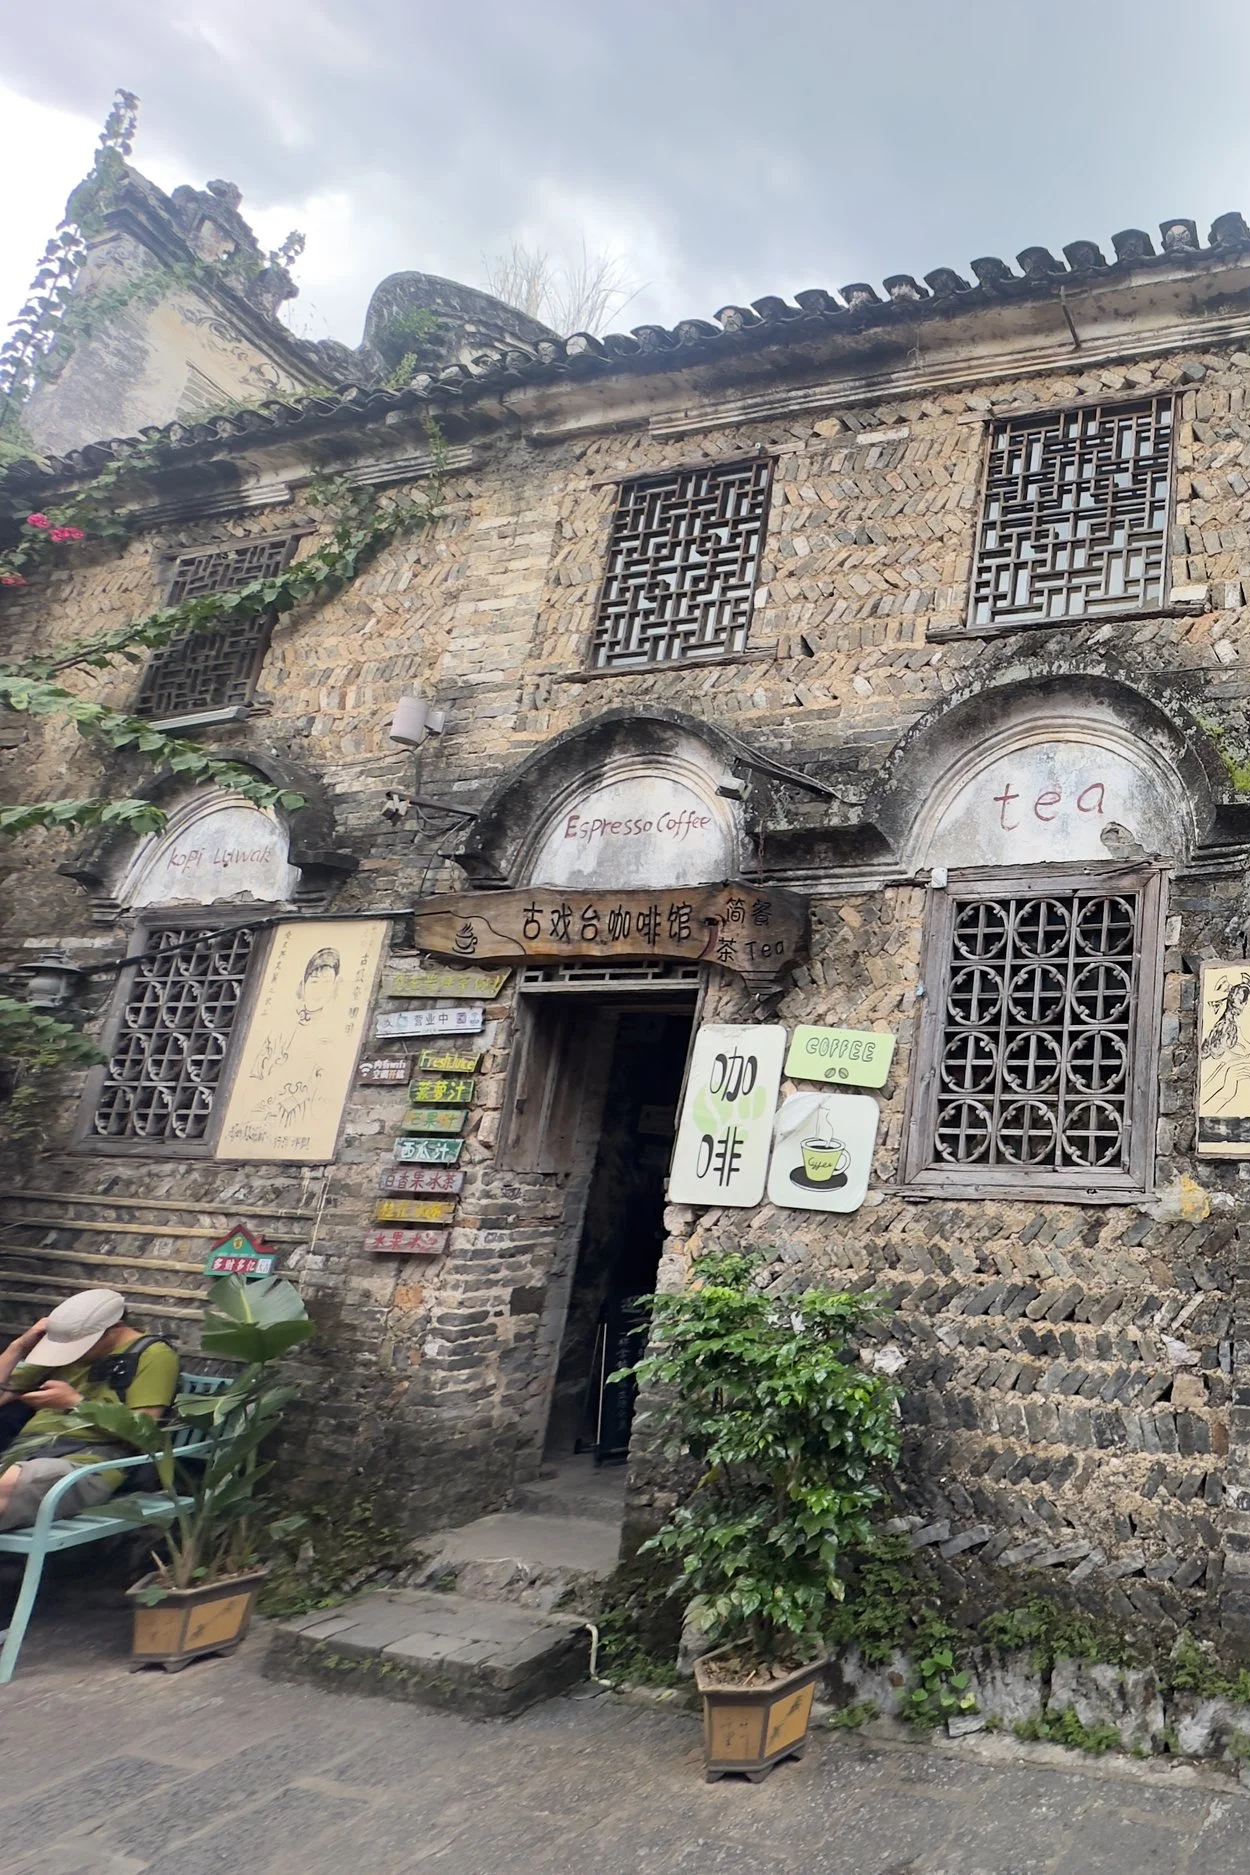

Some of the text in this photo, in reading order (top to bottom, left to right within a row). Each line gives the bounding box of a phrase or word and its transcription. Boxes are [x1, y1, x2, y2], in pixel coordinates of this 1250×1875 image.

[993, 782, 1105, 831] tea
[564, 809, 711, 844] Espresso Coffee
[522, 901, 693, 946] 古戏台咖啡馆
[716, 936, 784, 962] 茶 Tea
[414, 1012, 449, 1027] 营业中
[805, 1036, 876, 1063] COFFEE
[415, 1080, 466, 1101] 菠萝汁
[410, 1111, 459, 1130] 芒果汁
[696, 1046, 758, 1188] 咖啡
[400, 1140, 450, 1160] 西瓜汁
